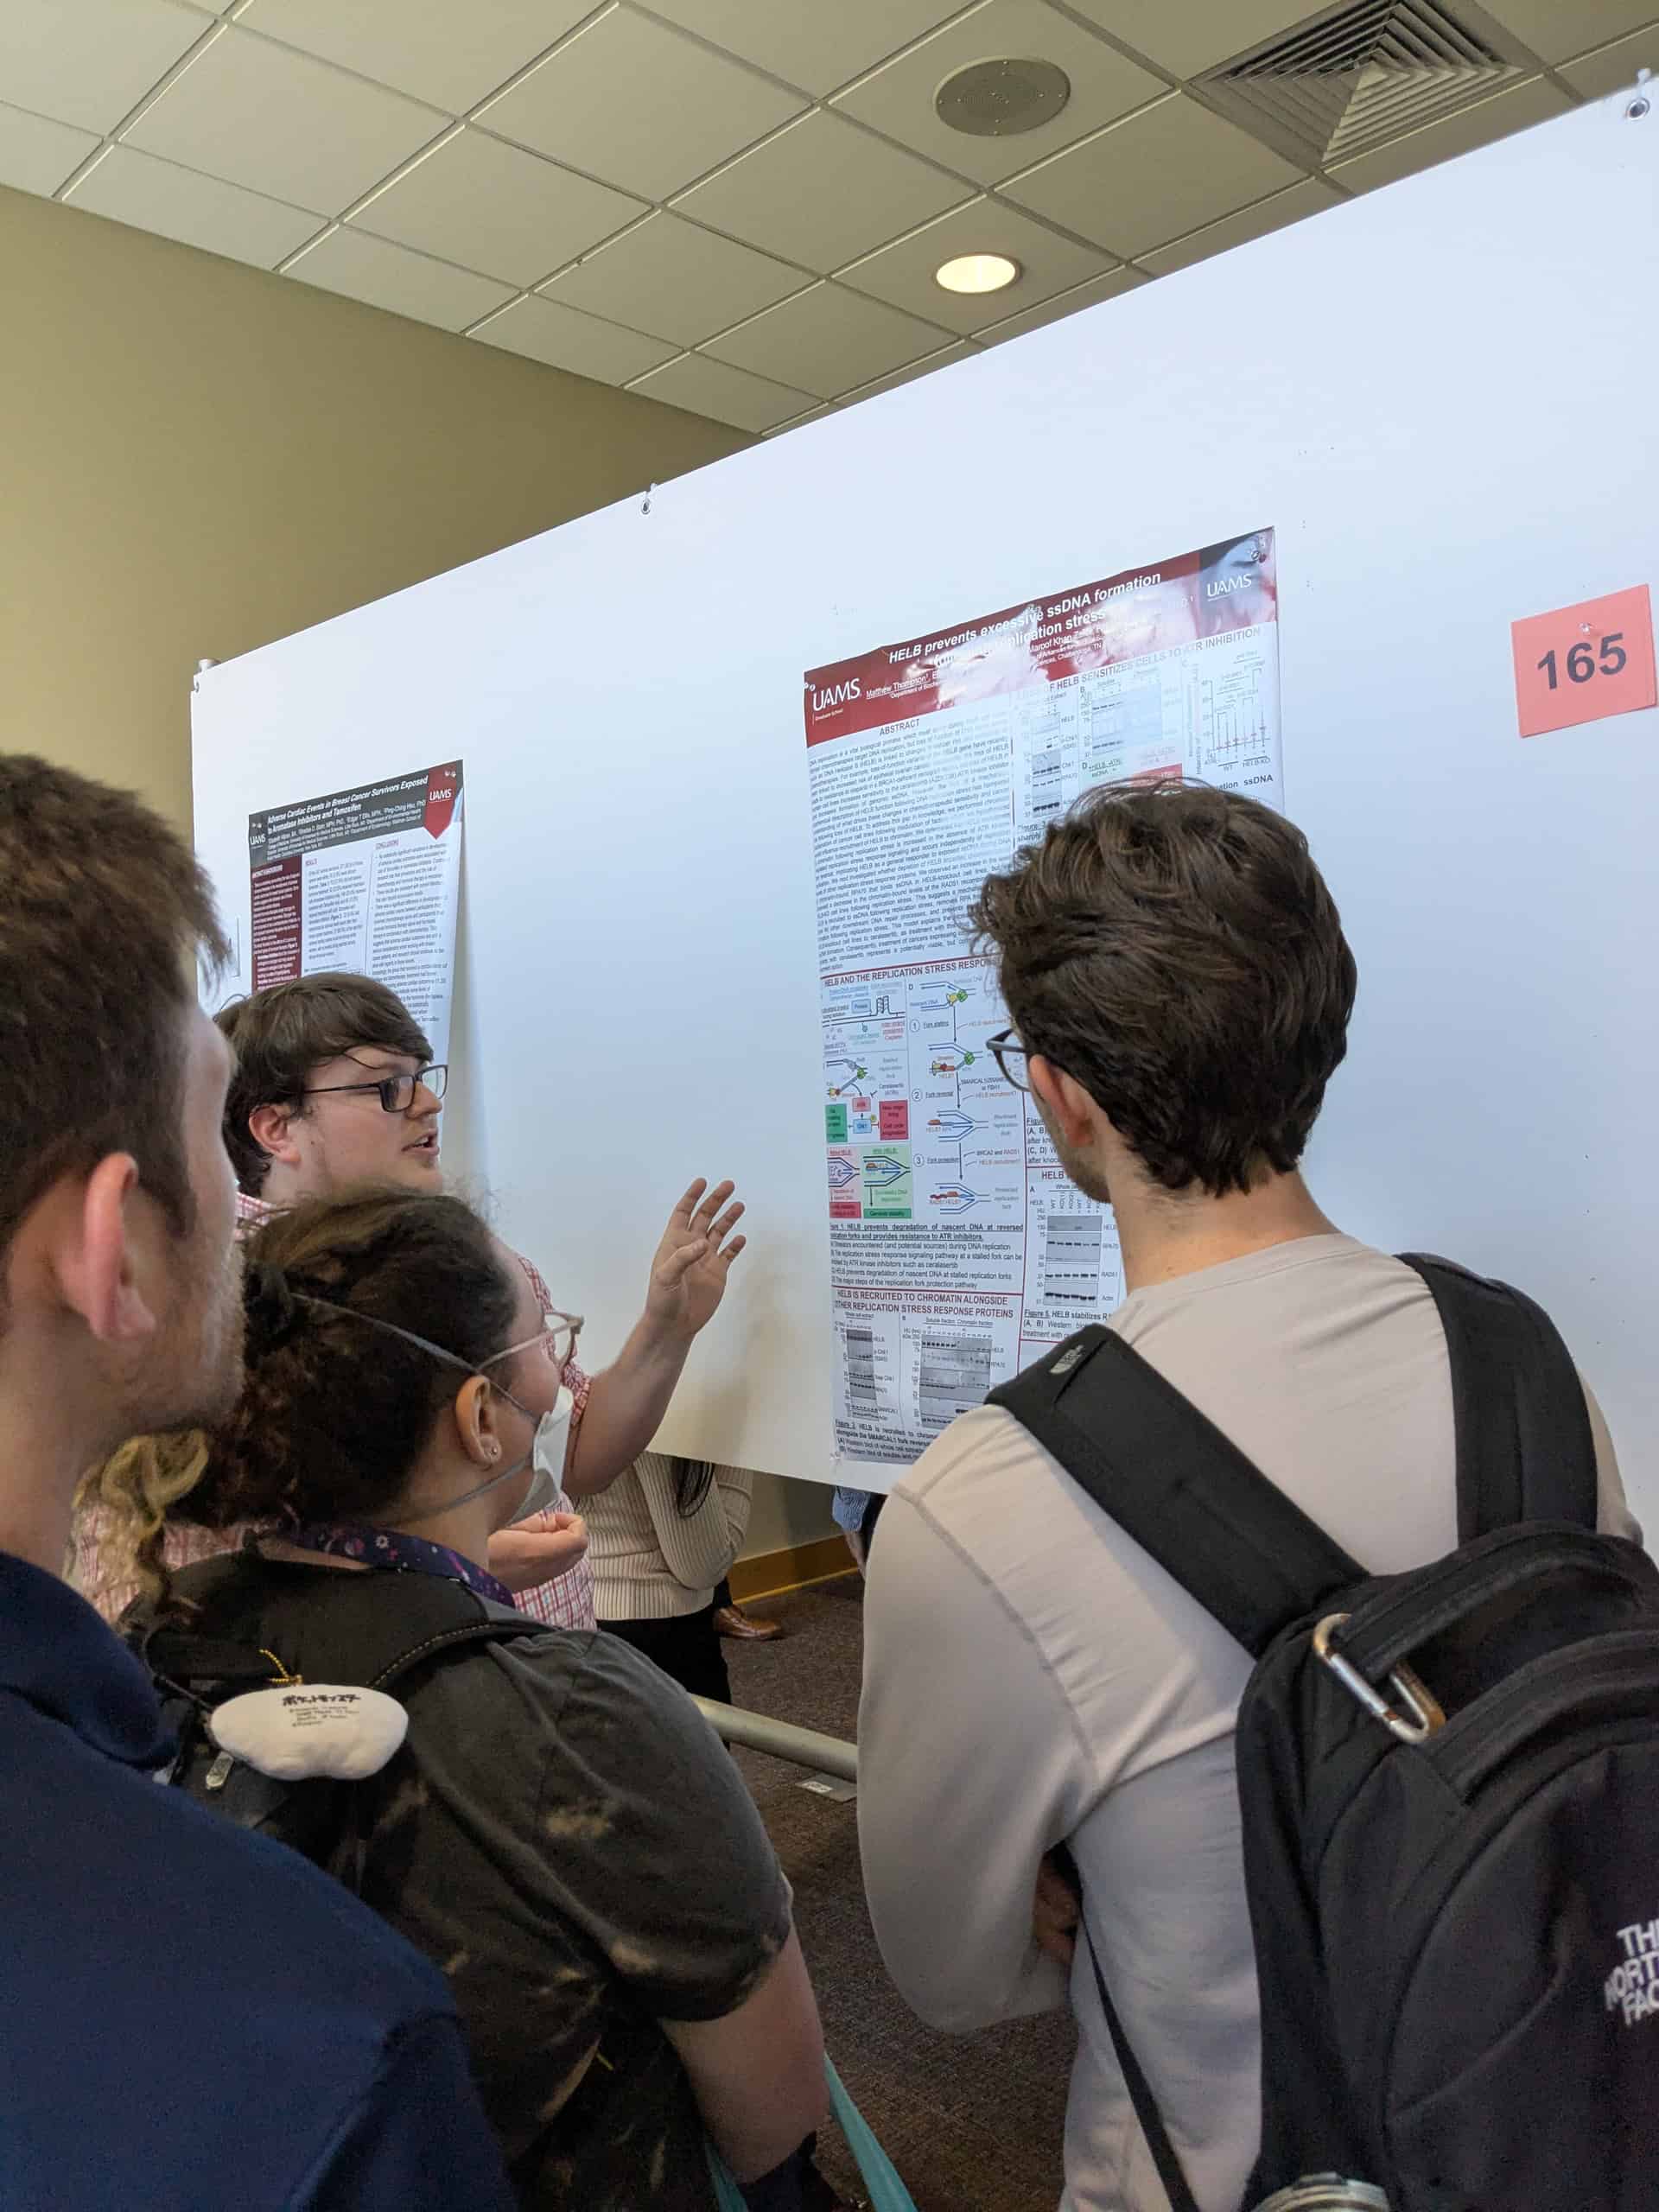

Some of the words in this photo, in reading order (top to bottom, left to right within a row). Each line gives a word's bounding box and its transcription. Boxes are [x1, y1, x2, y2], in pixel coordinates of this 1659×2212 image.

[1205, 574, 1252, 598] UAMS
[889, 644, 923, 664] HELB
[925, 627, 977, 657] prevents
[980, 608, 1044, 638] excessive
[1046, 596, 1092, 620] ssDNA
[1094, 573, 1161, 603] formation
[1537, 632, 1627, 690] 165
[1057, 675, 1079, 691] HELB
[812, 677, 861, 711] UAMS
[879, 718, 920, 736] ABSTRACT
[401, 776, 429, 790] Exposed
[1243, 773, 1274, 786] ssDNA
[841, 973, 855, 985] AND
[856, 971, 871, 982] THE
[872, 966, 924, 982] REPLICATION
[925, 961, 957, 975] STRESS
[1042, 1171, 1065, 1179] HELB
[969, 1271, 997, 1280] replication
[852, 1290, 859, 1299] IS
[860, 1291, 903, 1300] RECRUITED
[903, 1293, 915, 1301] TO
[917, 1293, 963, 1303] CHROMATIN
[964, 1295, 1008, 1306] ALONGSIDE
[853, 1301, 899, 1312] REPLICATION
[901, 1304, 932, 1313] STRESS
[933, 1306, 975, 1316] RESPONSE
[976, 1307, 1014, 1319] PROTEINS
[1052, 1310, 1070, 1319] HELB
[1616, 1918, 1659, 1957] TH
[1604, 1949, 1659, 2012] NORT
[1621, 1979, 1659, 2027] FAC
